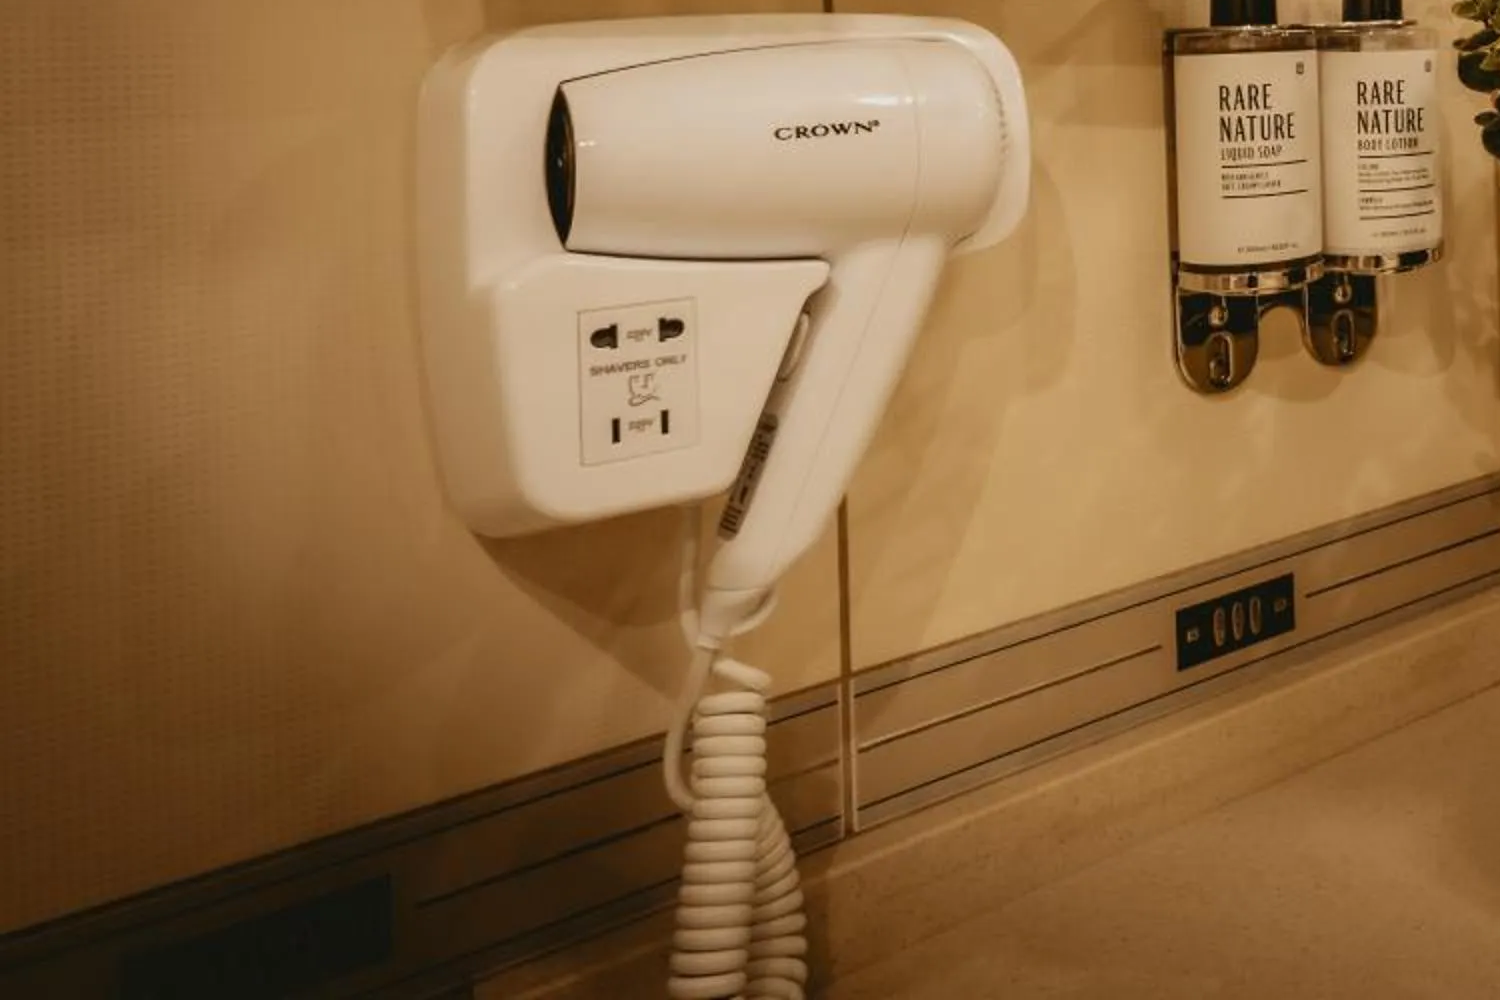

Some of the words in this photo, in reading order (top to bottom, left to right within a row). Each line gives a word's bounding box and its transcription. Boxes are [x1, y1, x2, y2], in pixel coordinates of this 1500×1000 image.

[1218, 83, 1273, 112] RARE
[1356, 79, 1406, 106] RARE
[1219, 111, 1297, 143] NATURE
[1356, 106, 1425, 135] NATURE
[1221, 146, 1255, 161] LIQUID
[1257, 144, 1283, 159] SOAP
[1357, 138, 1383, 151] BODY
[1385, 136, 1419, 150] LOTION
[589, 356, 652, 377] SHAVERS
[654, 353, 688, 368] ONLY
